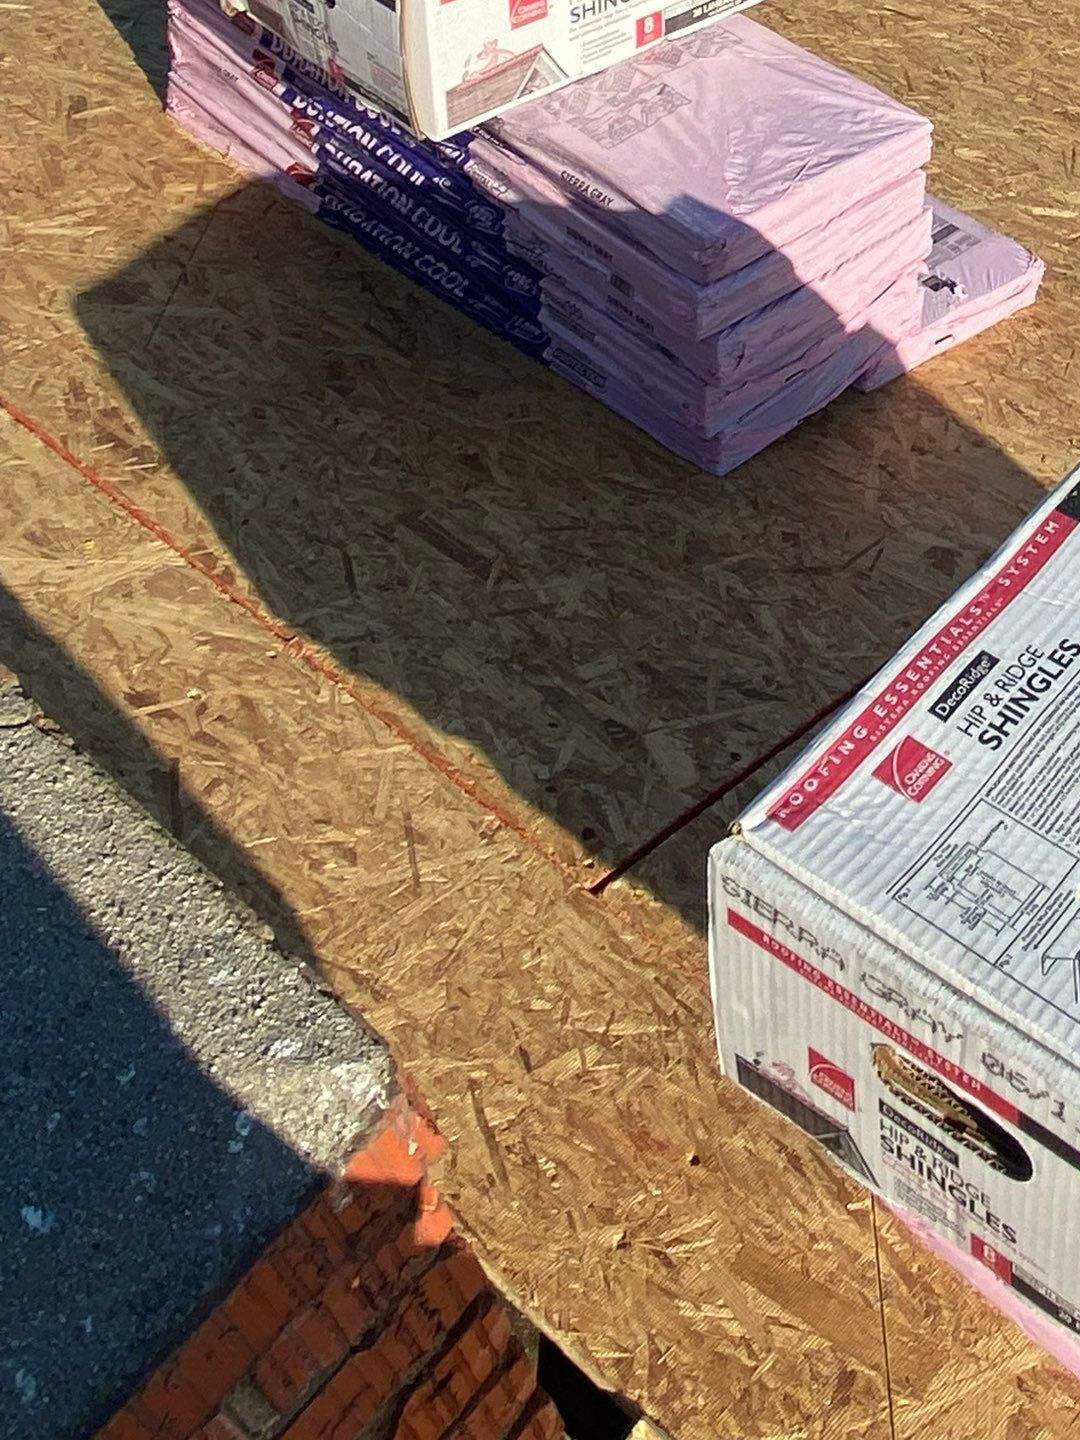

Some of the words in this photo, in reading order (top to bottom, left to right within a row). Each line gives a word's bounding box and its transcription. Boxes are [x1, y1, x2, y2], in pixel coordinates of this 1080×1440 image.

[411, 206, 463, 255] COOL
[415, 253, 469, 298] COOL
[774, 725, 868, 818] ROOFING
[992, 521, 1059, 586] SYSTEM
[956, 705, 987, 738] HIP
[983, 692, 1004, 708] &
[994, 644, 1045, 693] RIDGE
[721, 875, 845, 971] SIERRA
[860, 972, 965, 1043] GRAY
[879, 1118, 909, 1145] HIP
[914, 1145, 927, 1162] &
[936, 1159, 991, 1210] RIDGE
[880, 1135, 1016, 1243] SHINGLES
